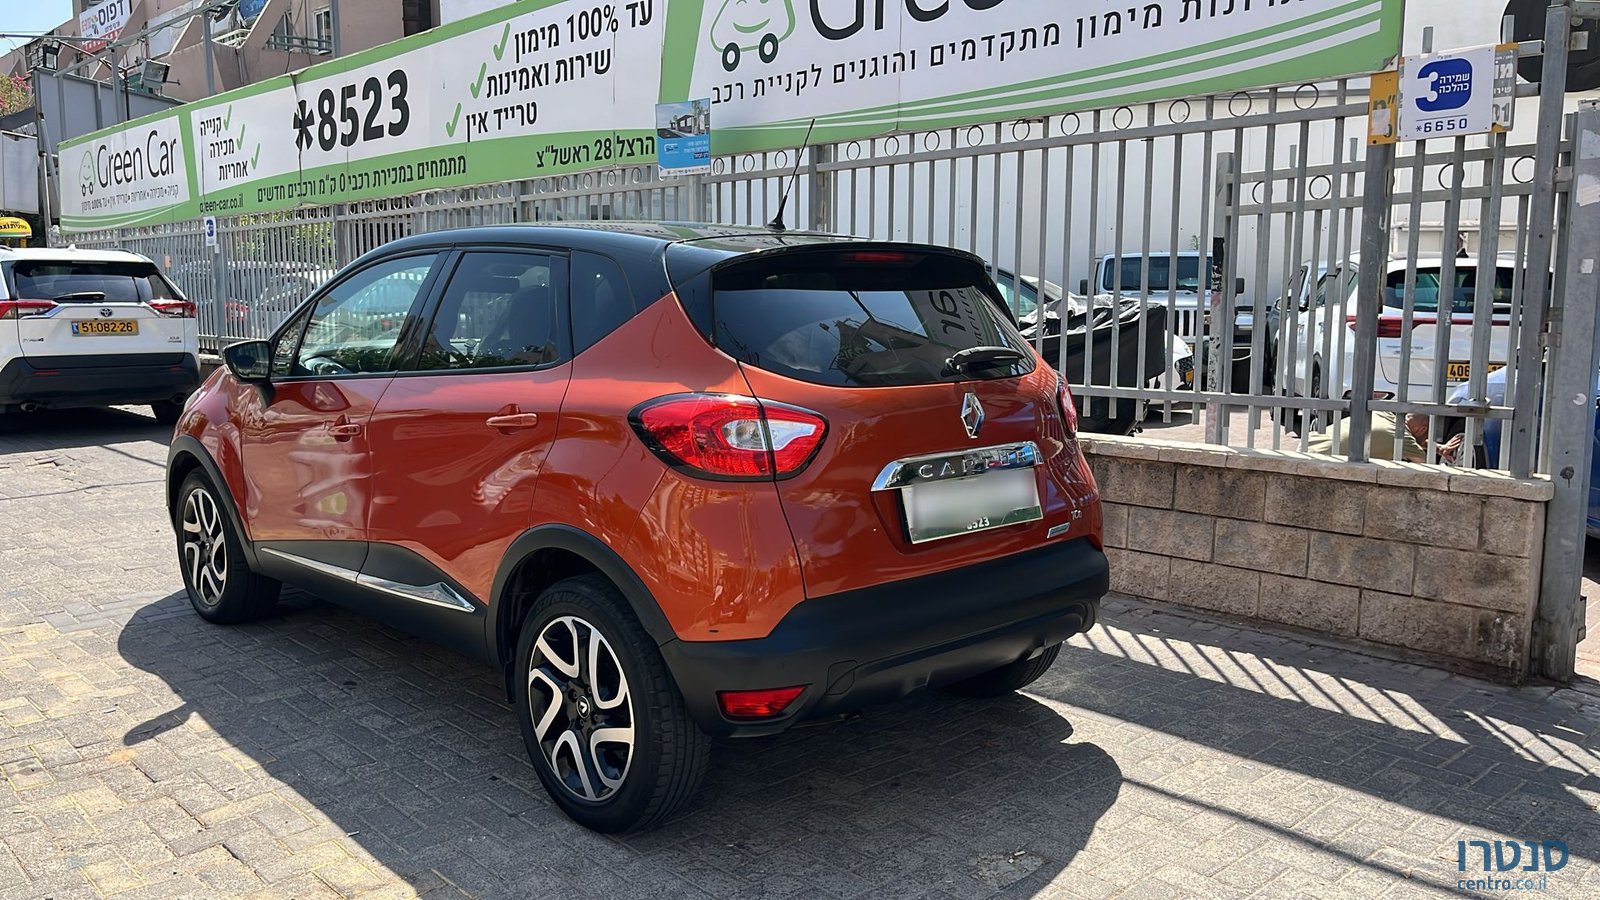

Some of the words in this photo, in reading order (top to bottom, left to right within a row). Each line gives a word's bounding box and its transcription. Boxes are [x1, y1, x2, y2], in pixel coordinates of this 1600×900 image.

[566, 4, 619, 43] 100%
[625, 0, 653, 28] עד
[1076, 2, 1162, 48] מימון
[514, 23, 560, 64] מימון
[930, 22, 1061, 67] מתקדמים
[555, 48, 611, 84] שירות
[833, 49, 916, 84] והוגנים
[1439, 73, 1470, 84] שמירה
[486, 62, 549, 99] ואמינות
[711, 82, 744, 105] רכב
[752, 63, 822, 97] לקניית
[1439, 82, 1470, 94] כהלכה
[200, 116, 222, 138] קנייה
[466, 111, 489, 143] אין
[493, 101, 538, 131] טרייד
[97, 144, 144, 188] Green
[146, 129, 177, 178] Car
[209, 138, 235, 159] מכירה
[594, 137, 613, 161] 28
[616, 135, 655, 158] הרצל
[218, 160, 249, 181] אחריות
[347, 172, 370, 191] רכבי
[372, 164, 414, 188] במכירת
[417, 155, 467, 181] מתמחים
[257, 184, 286, 203] חדשים
